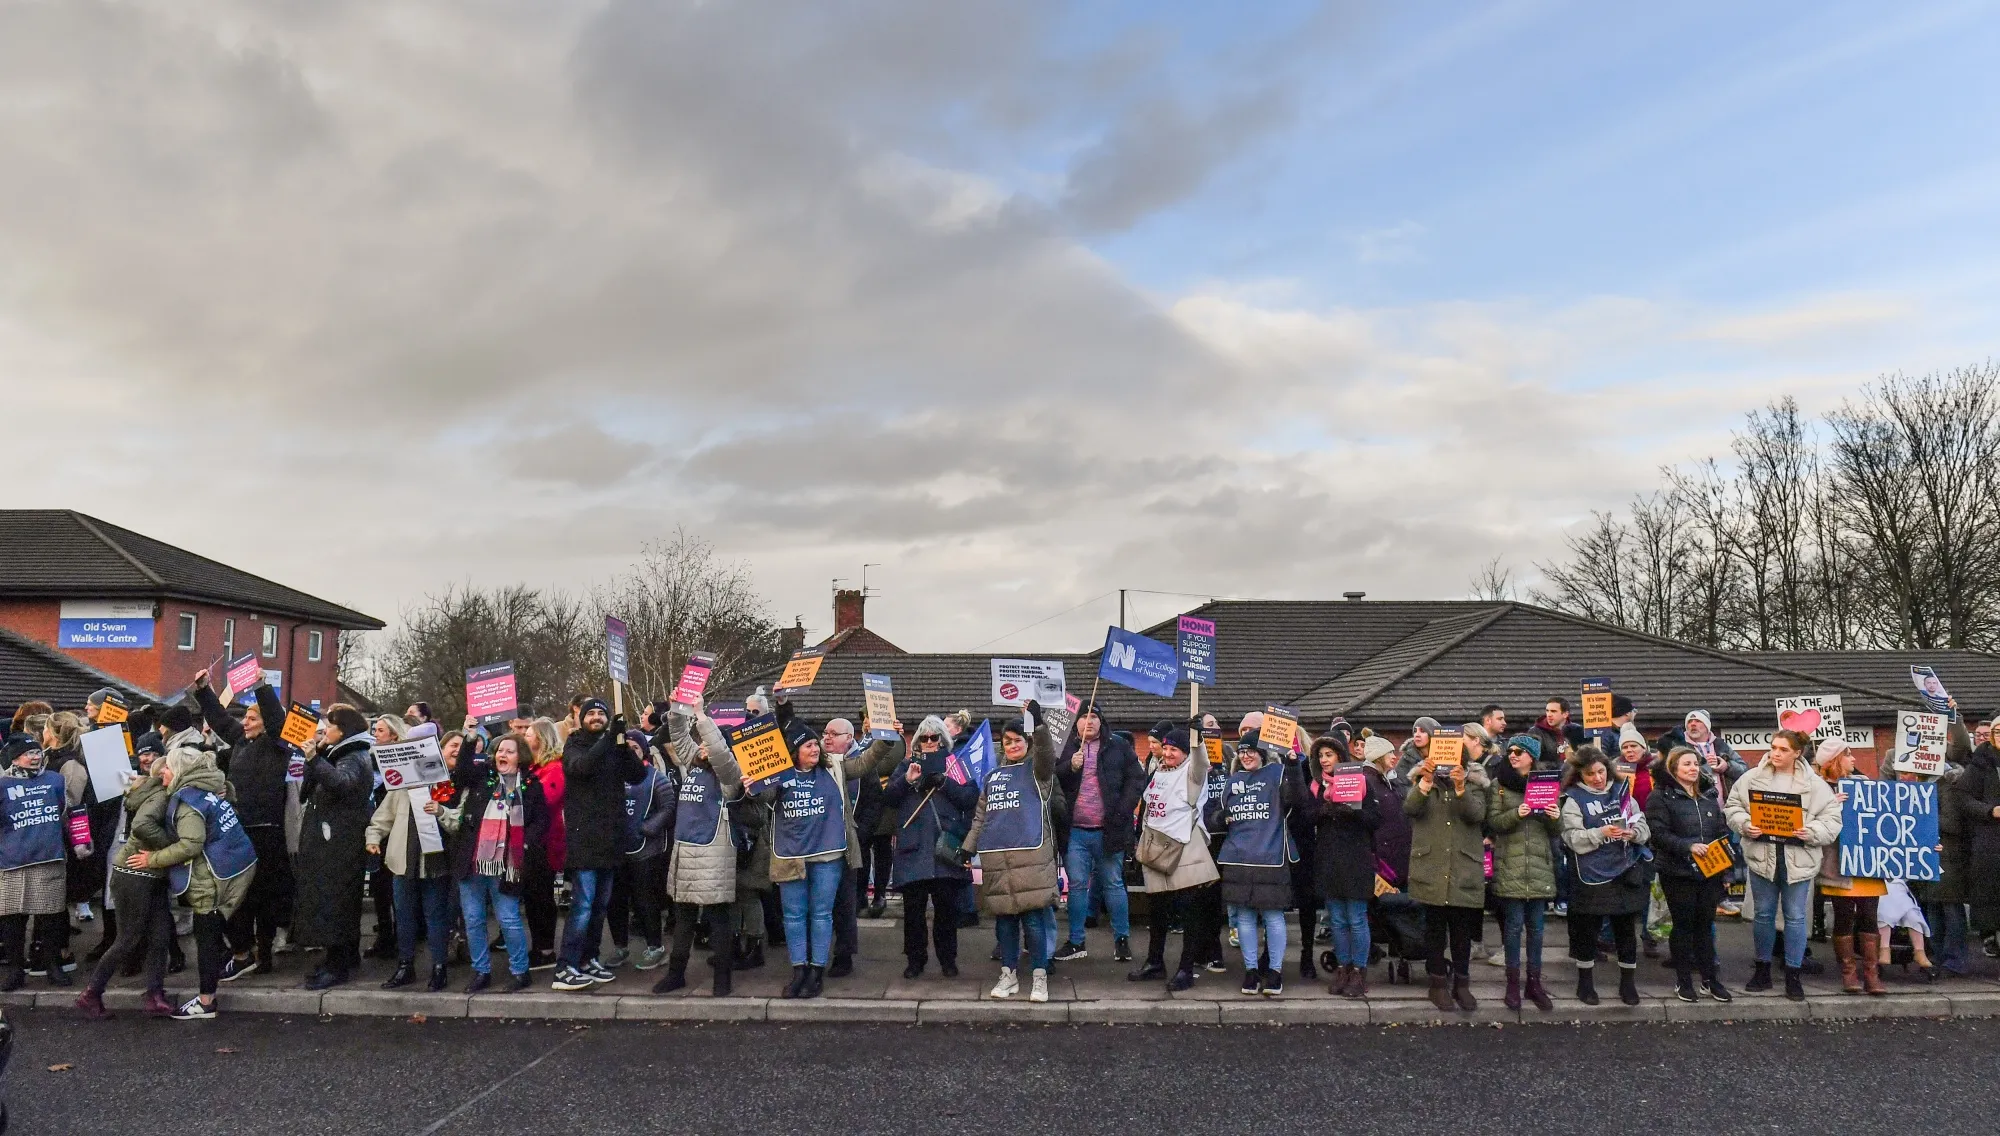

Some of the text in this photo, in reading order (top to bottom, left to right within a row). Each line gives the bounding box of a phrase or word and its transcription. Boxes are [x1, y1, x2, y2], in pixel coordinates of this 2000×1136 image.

[84, 623, 126, 631] Old Swan
[1182, 620, 1212, 633] HONK
[71, 634, 137, 643] Walk-In Centre
[1183, 640, 1210, 650] SUPPORT
[1183, 647, 1197, 655] FAIR
[1138, 657, 1177, 674] Royal College
[1182, 661, 1211, 672] NURSING
[1144, 668, 1167, 682] Nursing
[1777, 698, 1822, 709] FIX THE
[1047, 716, 1067, 731] FAIR PAY
[1049, 710, 1070, 725] SUPPORT
[1919, 715, 1939, 724] THE
[753, 721, 774, 733] NURSING
[1049, 725, 1060, 735] FOR
[1267, 728, 1288, 738] nursing
[1816, 726, 1842, 738] NHS
[742, 736, 774, 752] It's time
[1276, 736, 1290, 744] fairly
[1725, 733, 1761, 744] ROCK
[759, 745, 774, 756] pay
[748, 751, 780, 767] nursing
[1915, 752, 1941, 762] SHOULD
[747, 757, 787, 777] staff fairly
[1912, 762, 1937, 772] TAKE!
[692, 784, 705, 793] OF
[992, 783, 1006, 792] THE
[988, 790, 1019, 802] OICE OF
[1838, 780, 1934, 814] FAIR PAY
[22, 799, 44, 808] THE
[782, 797, 824, 809] VOICE OF
[986, 800, 1020, 812] URSING
[1229, 804, 1254, 812] VOICE
[10, 806, 58, 821] VOICE OF
[784, 806, 825, 818] NURSING
[13, 814, 60, 830] NURSING
[1858, 813, 1918, 846] FOR
[1840, 845, 1934, 881] NURSES
